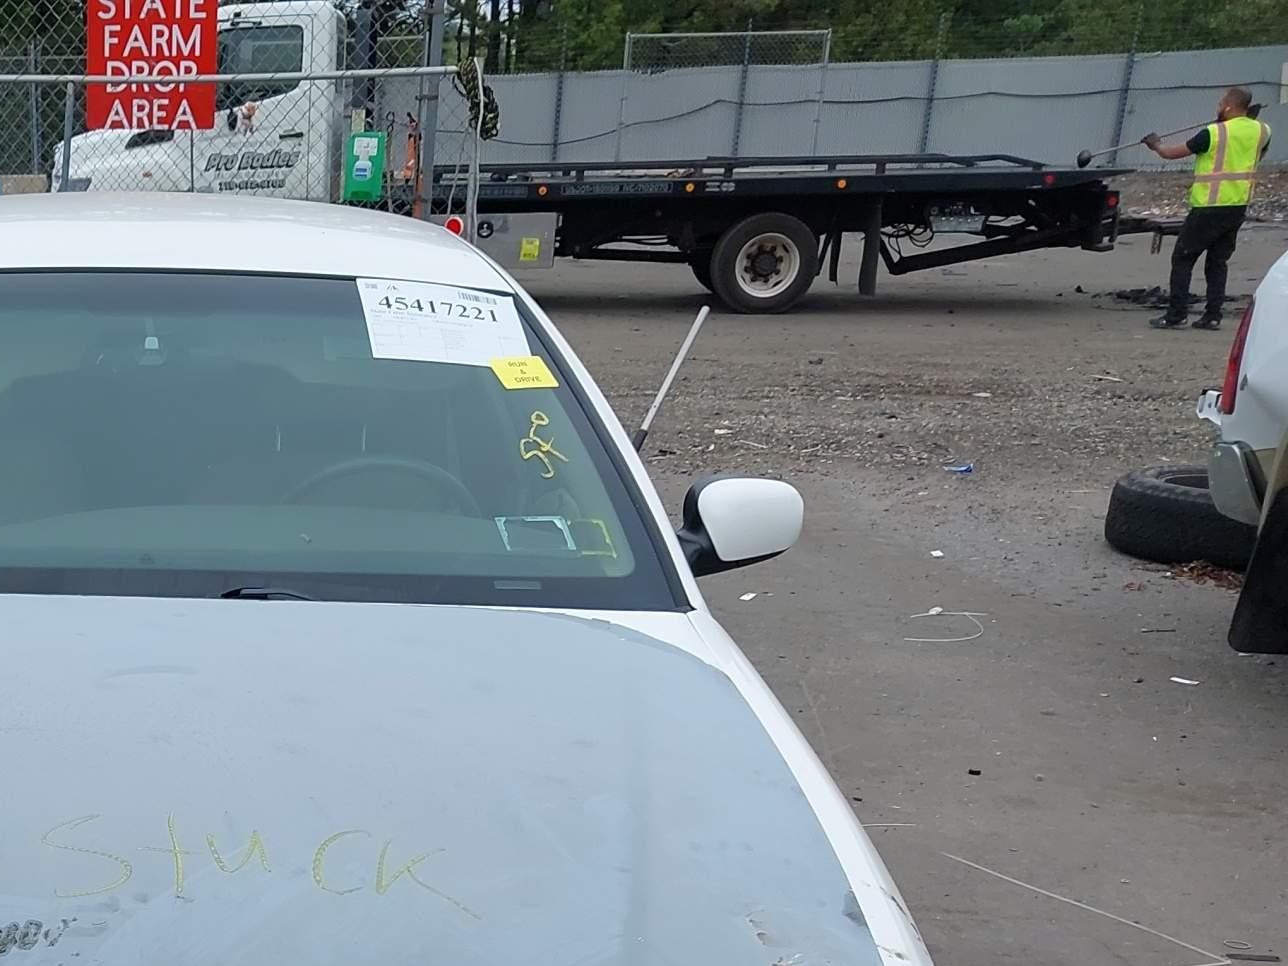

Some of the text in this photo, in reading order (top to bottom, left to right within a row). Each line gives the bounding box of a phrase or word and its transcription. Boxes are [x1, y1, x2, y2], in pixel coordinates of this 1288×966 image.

[103, 24, 201, 57] FARM
[106, 60, 197, 93] DROP
[103, 98, 198, 130] AREA
[378, 295, 498, 322] 45417221
